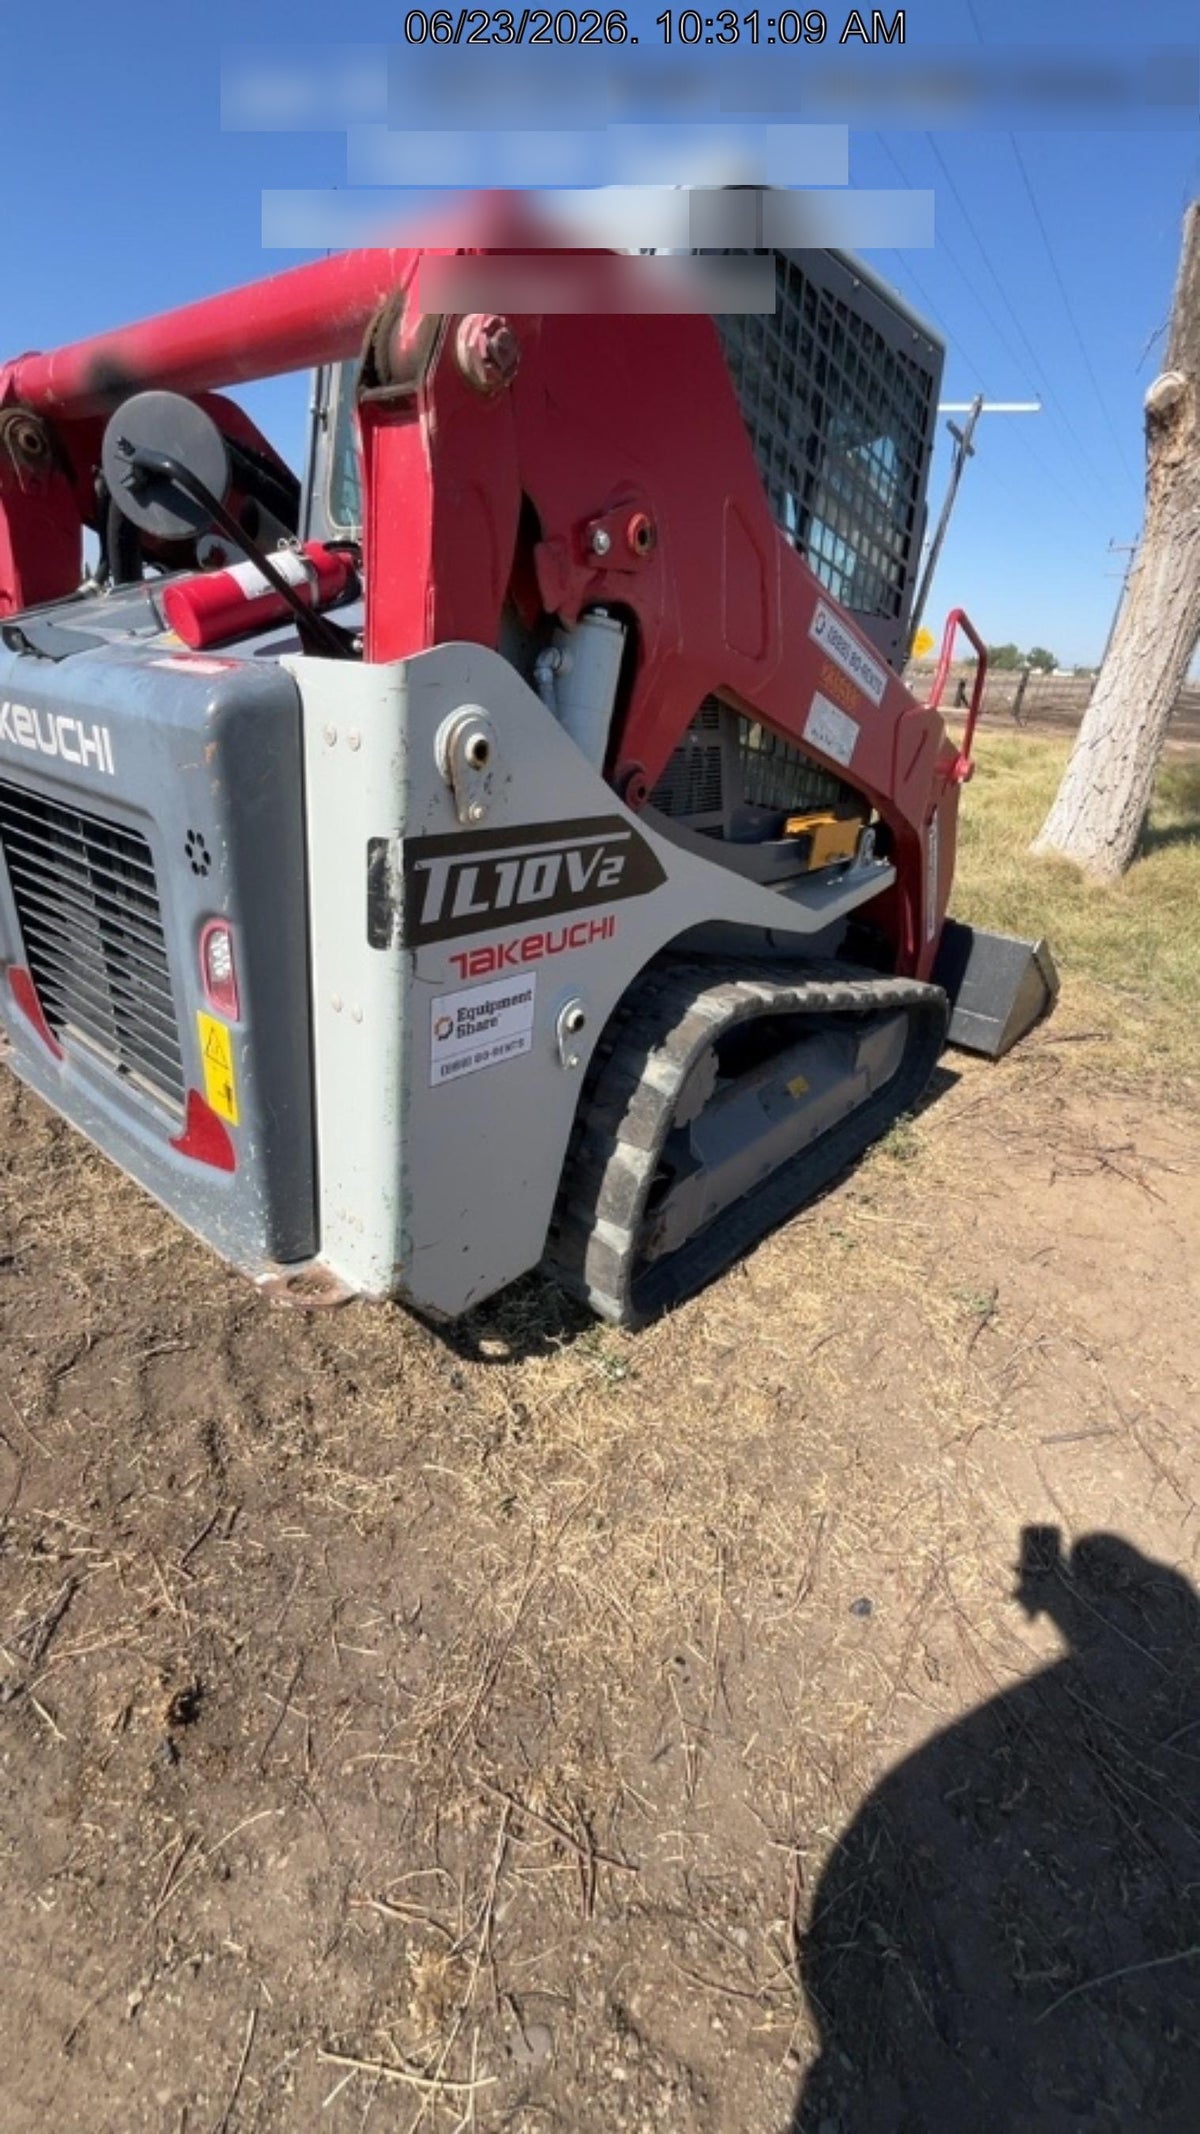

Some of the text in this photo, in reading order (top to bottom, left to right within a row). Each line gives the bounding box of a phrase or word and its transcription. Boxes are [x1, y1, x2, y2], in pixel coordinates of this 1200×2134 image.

[413, 831, 631, 926] TL10V2
[456, 988, 532, 1022] Equipment
[456, 1016, 499, 1039] Share
